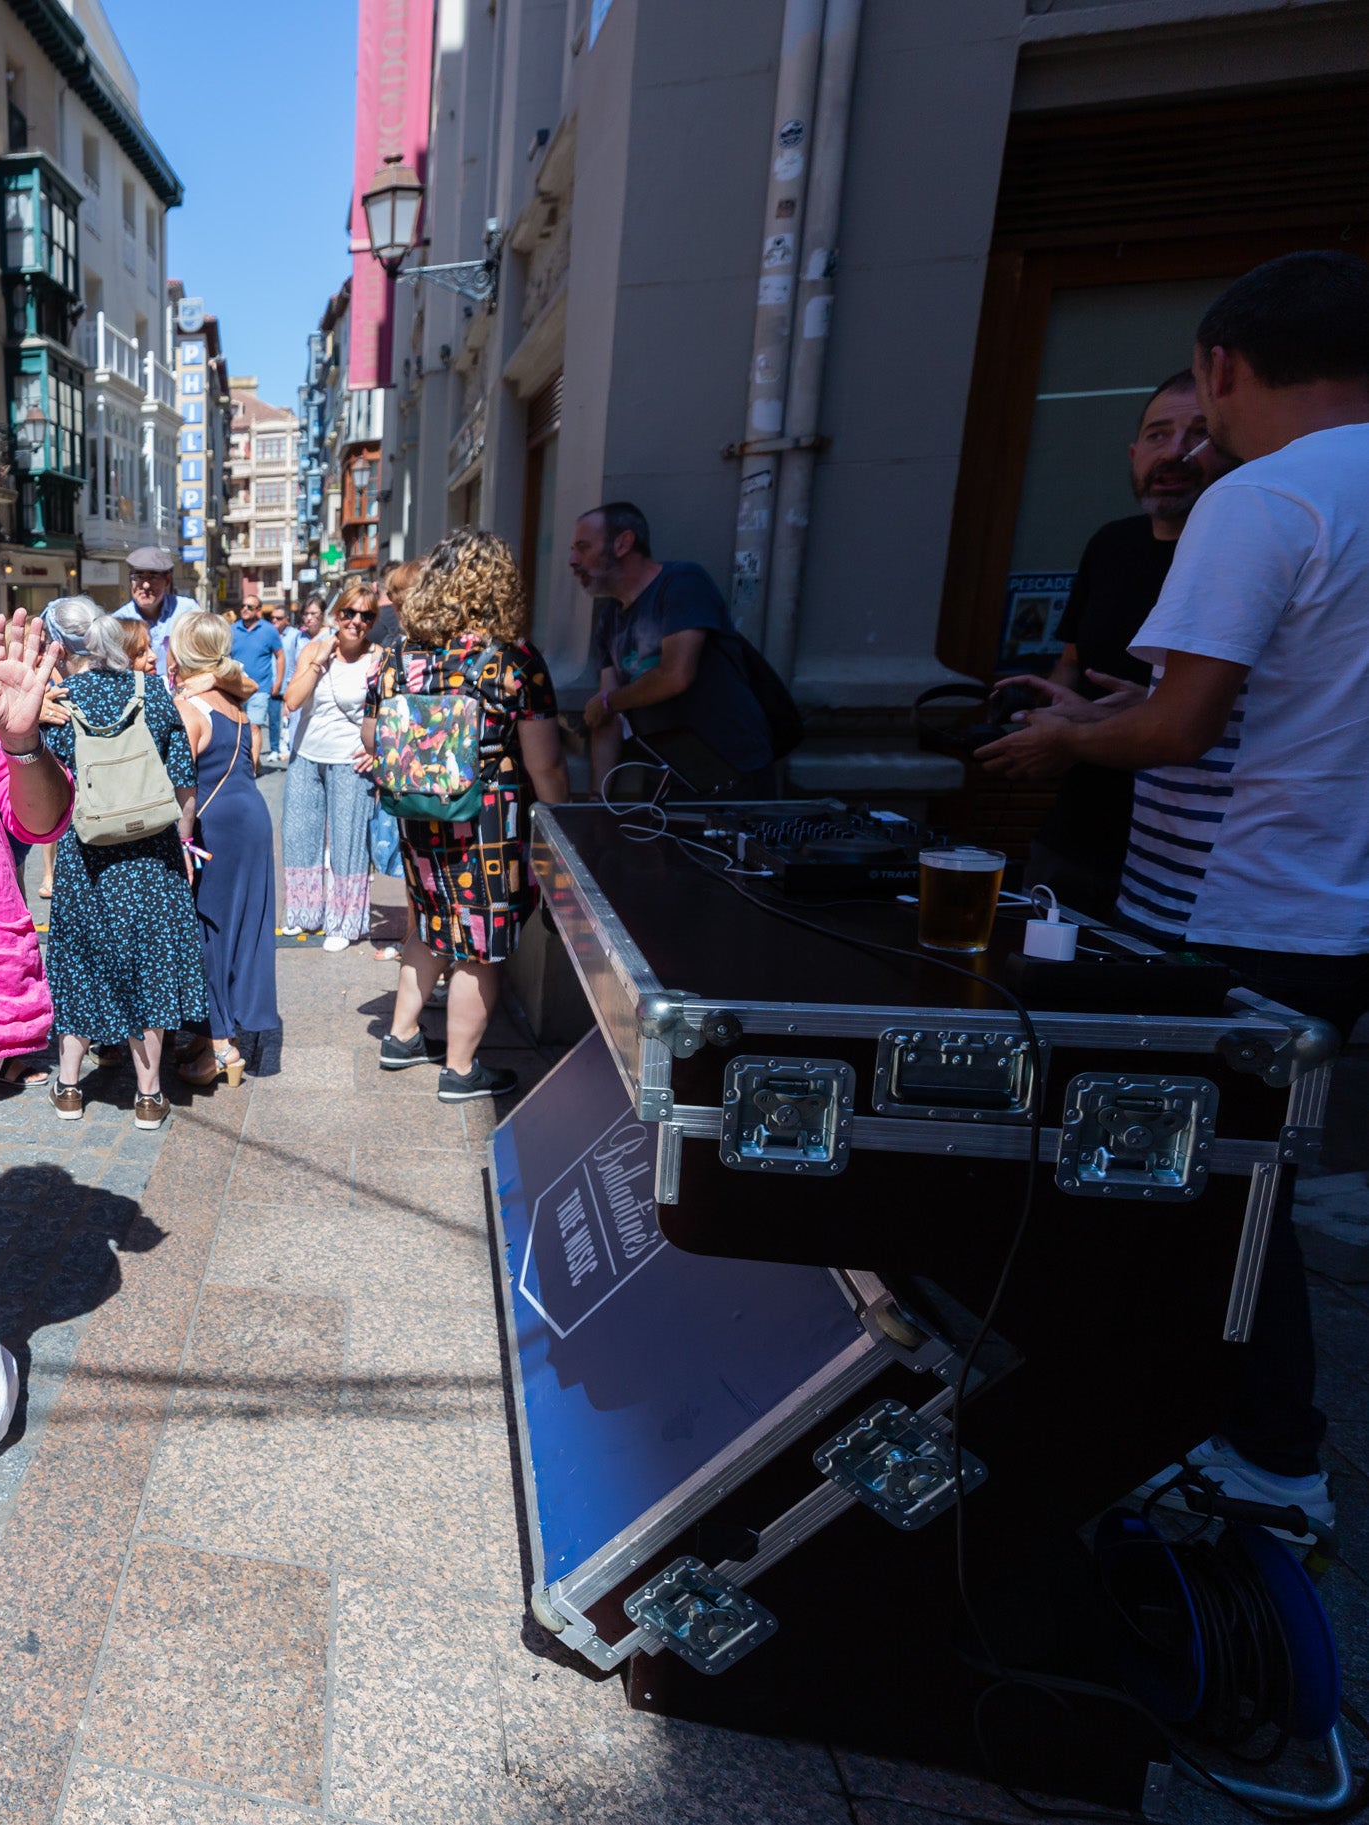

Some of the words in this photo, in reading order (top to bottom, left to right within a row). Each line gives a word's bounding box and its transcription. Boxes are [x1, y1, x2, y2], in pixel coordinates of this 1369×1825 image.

[378, 28, 409, 160] RCADO
[183, 342, 203, 538] PHILIPS
[880, 869, 919, 880] TRAKT
[556, 1187, 587, 1239] TRUE
[593, 1123, 658, 1260] Ballantine's
[564, 1223, 599, 1287] MUSIC
